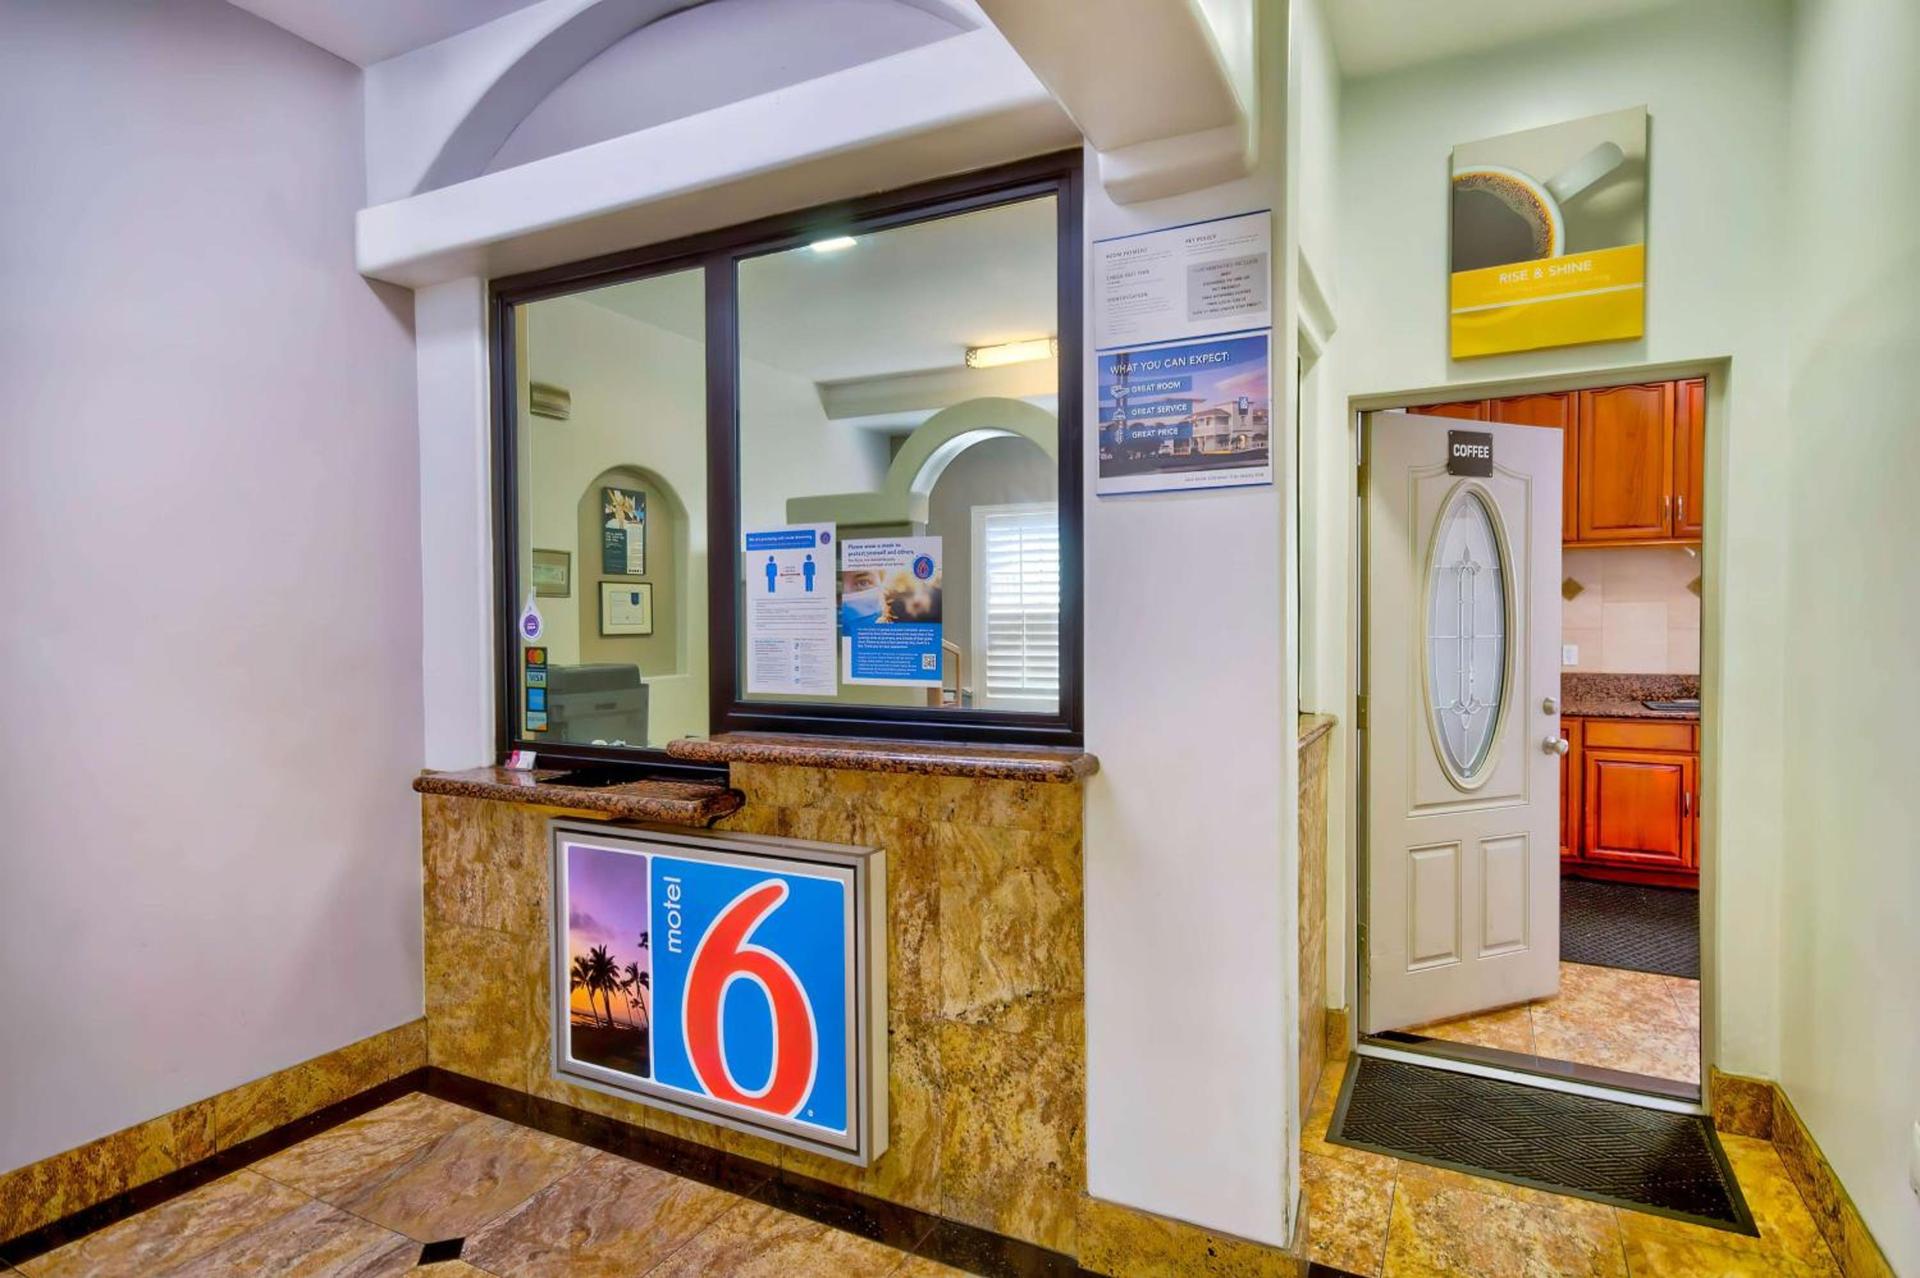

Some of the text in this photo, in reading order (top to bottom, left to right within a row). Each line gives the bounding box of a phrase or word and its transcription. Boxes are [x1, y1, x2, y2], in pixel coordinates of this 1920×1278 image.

[1499, 260, 1592, 283] RISE & SHINE
[1110, 351, 1230, 376] WHAT YOU CAN EXPECT:
[1131, 381, 1181, 393] GREAT ROOM
[1131, 403, 1187, 416] GREAT SERVICE
[1132, 427, 1179, 439] GREAT PRICE
[1453, 443, 1489, 458] COFFEE
[662, 876, 818, 1119] motel 6
